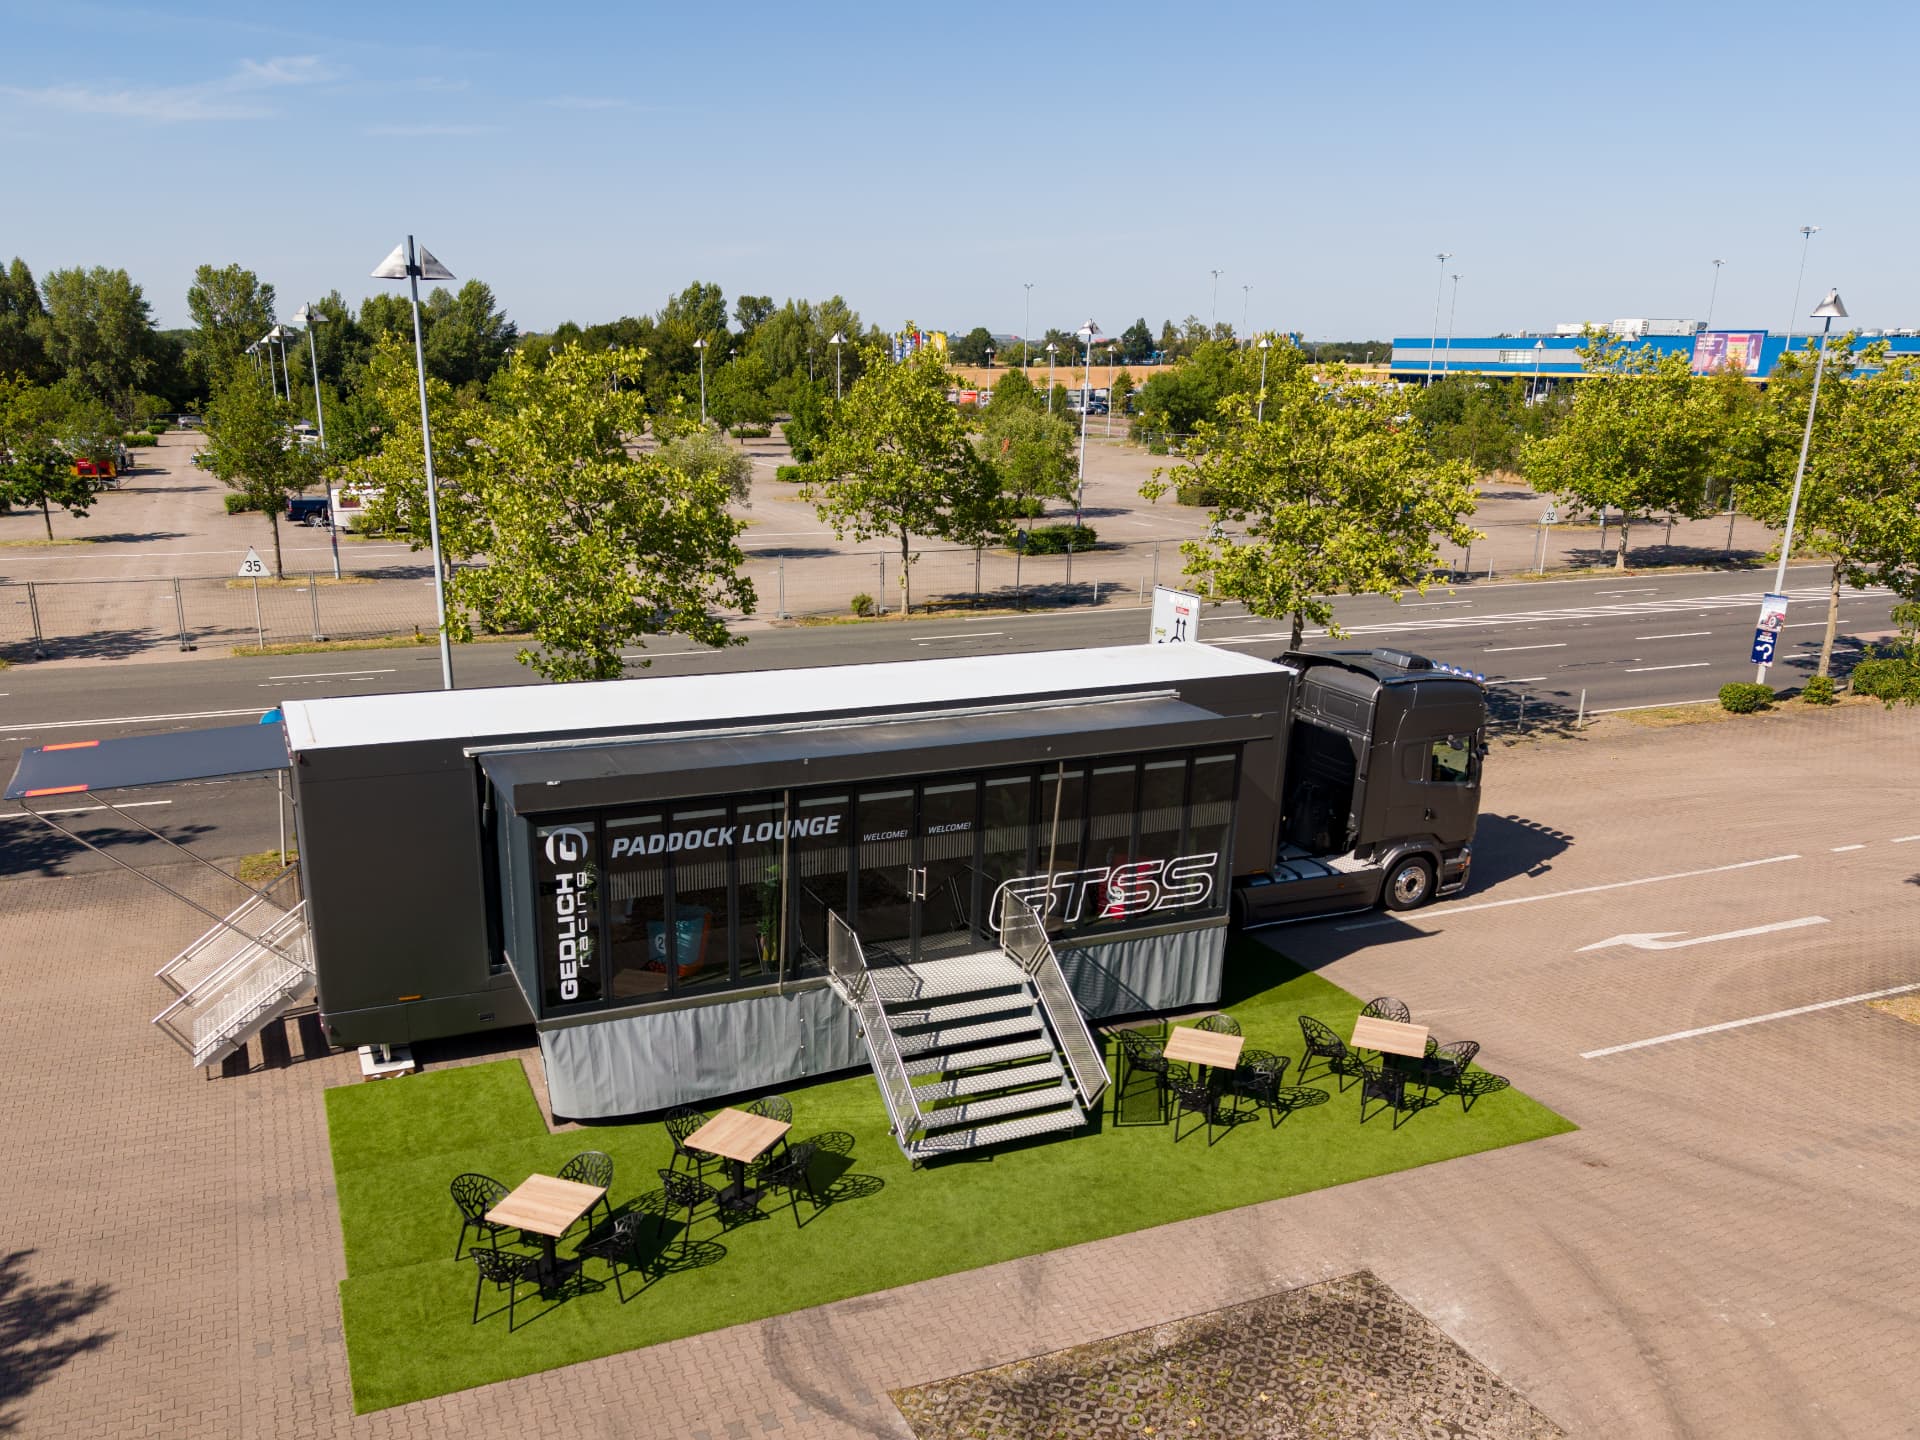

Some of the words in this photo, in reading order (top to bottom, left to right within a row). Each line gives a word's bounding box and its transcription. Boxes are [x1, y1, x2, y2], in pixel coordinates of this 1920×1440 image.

[1546, 511, 1555, 521] 32
[245, 560, 261, 572] 35
[928, 821, 972, 834] WELCOME!
[611, 825, 737, 859] PADDOCK
[742, 814, 841, 844] LOUNGE
[863, 829, 908, 841] WELCOME!
[576, 872, 590, 968] racing
[555, 873, 578, 1000] GEDLICH
